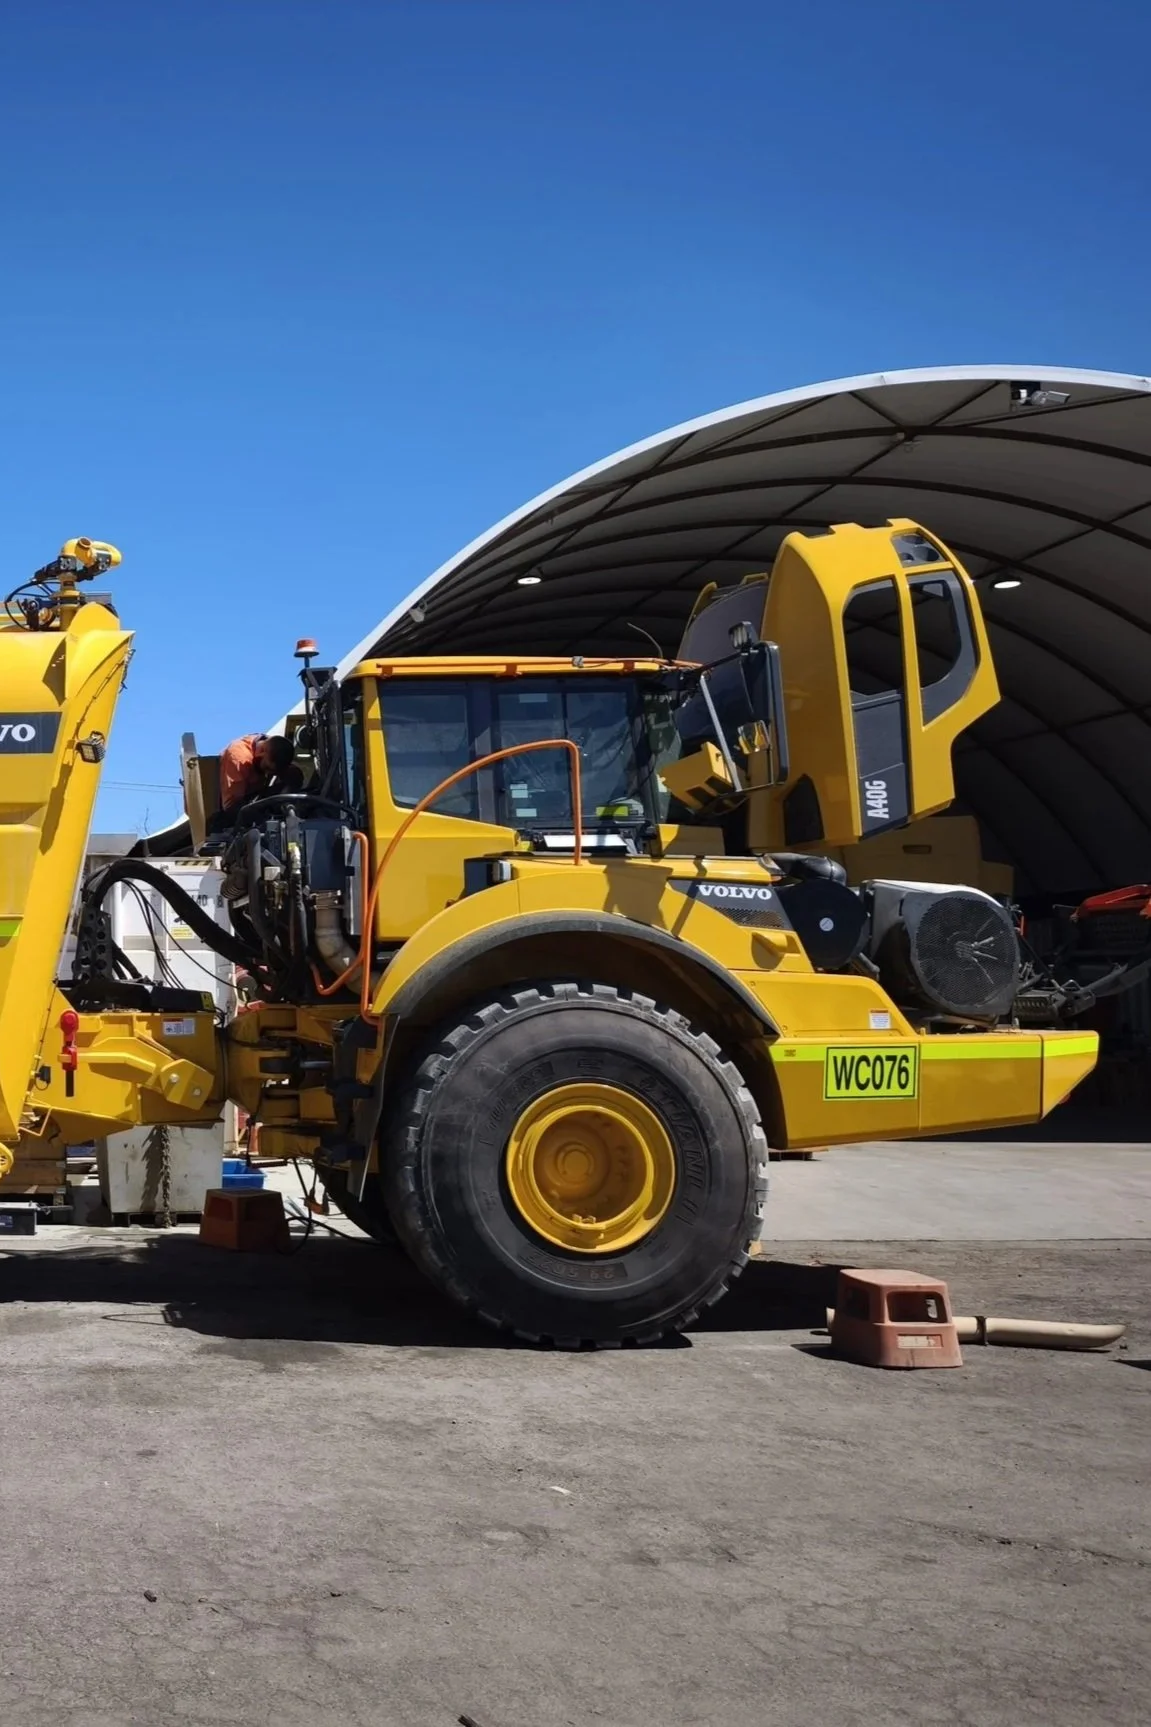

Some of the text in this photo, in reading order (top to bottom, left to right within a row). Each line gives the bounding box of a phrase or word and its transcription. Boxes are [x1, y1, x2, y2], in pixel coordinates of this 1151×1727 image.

[864, 780, 889, 819] A40G
[696, 884, 772, 900] VOLVO
[833, 1054, 910, 1091] WC076
